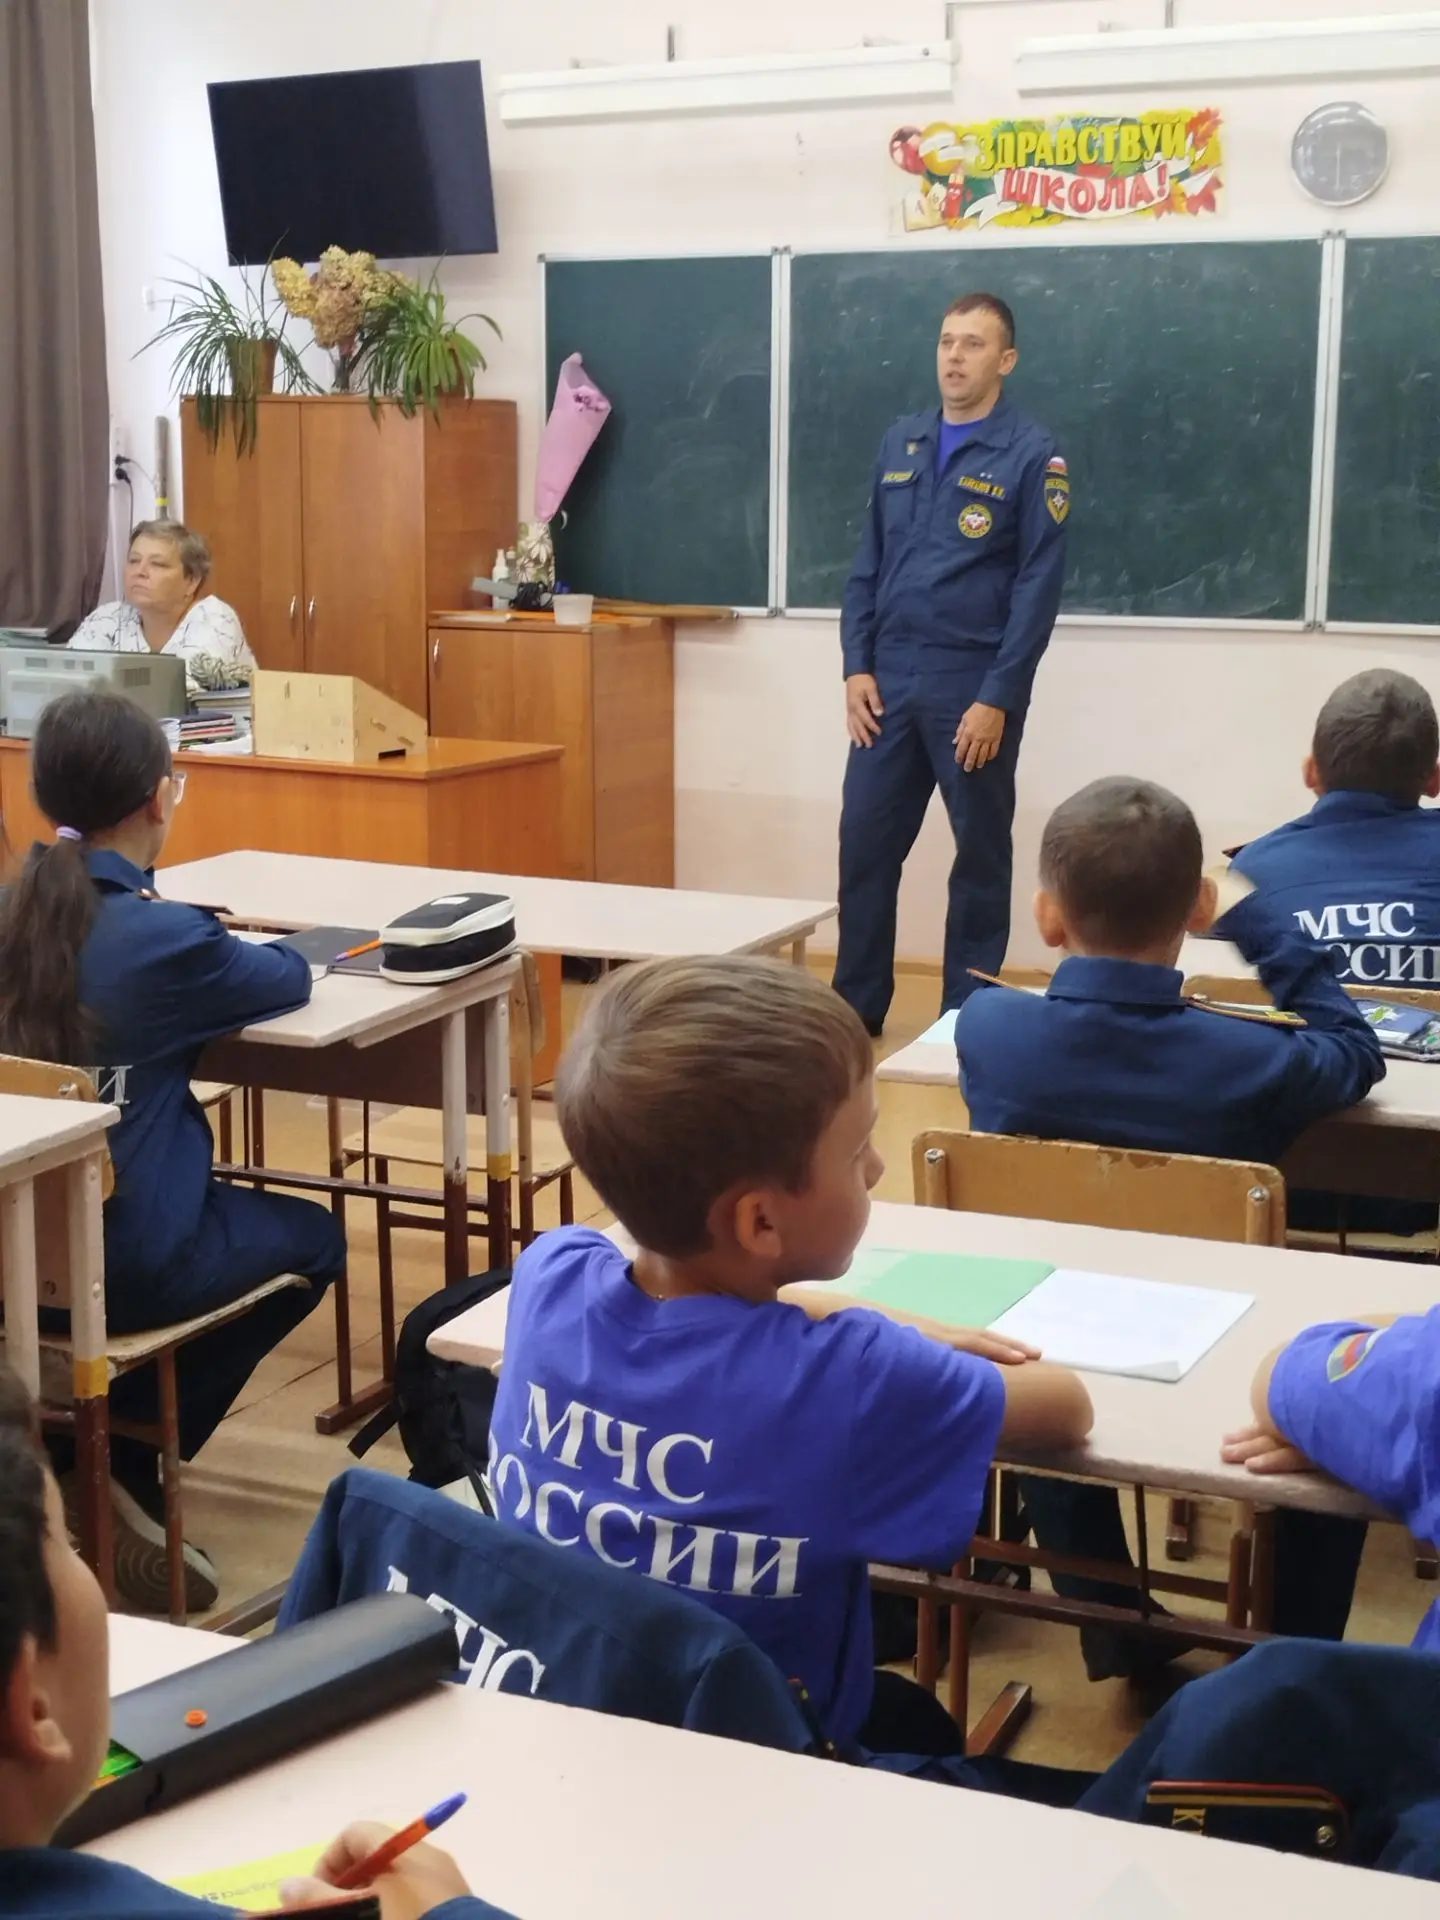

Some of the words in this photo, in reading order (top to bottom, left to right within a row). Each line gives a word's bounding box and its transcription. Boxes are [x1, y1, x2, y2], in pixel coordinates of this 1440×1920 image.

[1001, 163, 1169, 213] ШКОЛА!
[1292, 902, 1416, 941] МЧС
[519, 1380, 715, 1505] МЧС
